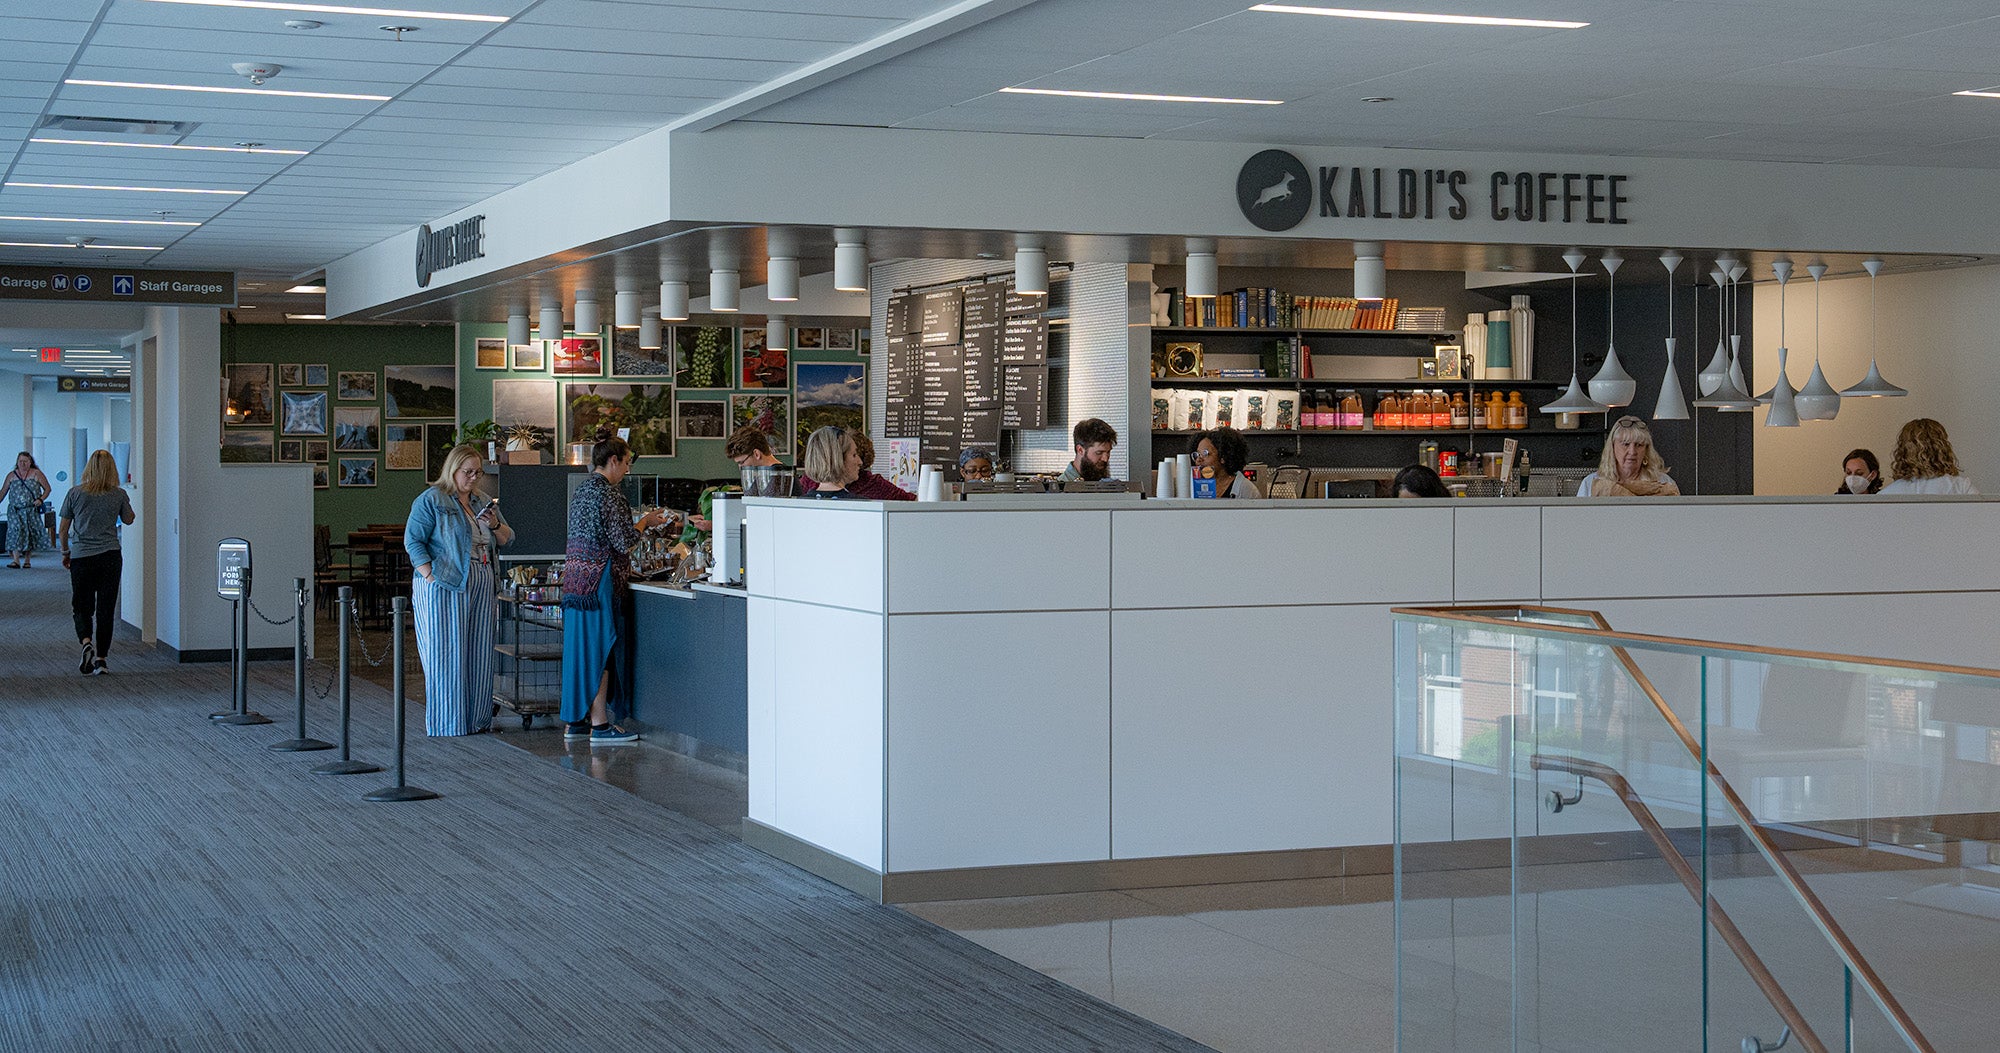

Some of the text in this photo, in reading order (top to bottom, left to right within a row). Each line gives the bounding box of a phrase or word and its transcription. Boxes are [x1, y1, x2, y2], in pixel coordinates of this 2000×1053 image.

[1319, 166, 1628, 225] KALDI'S COFFEE
[1, 276, 47, 290] Garage
[139, 280, 223, 294] Staff Garages
[108, 381, 128, 389] Garage
